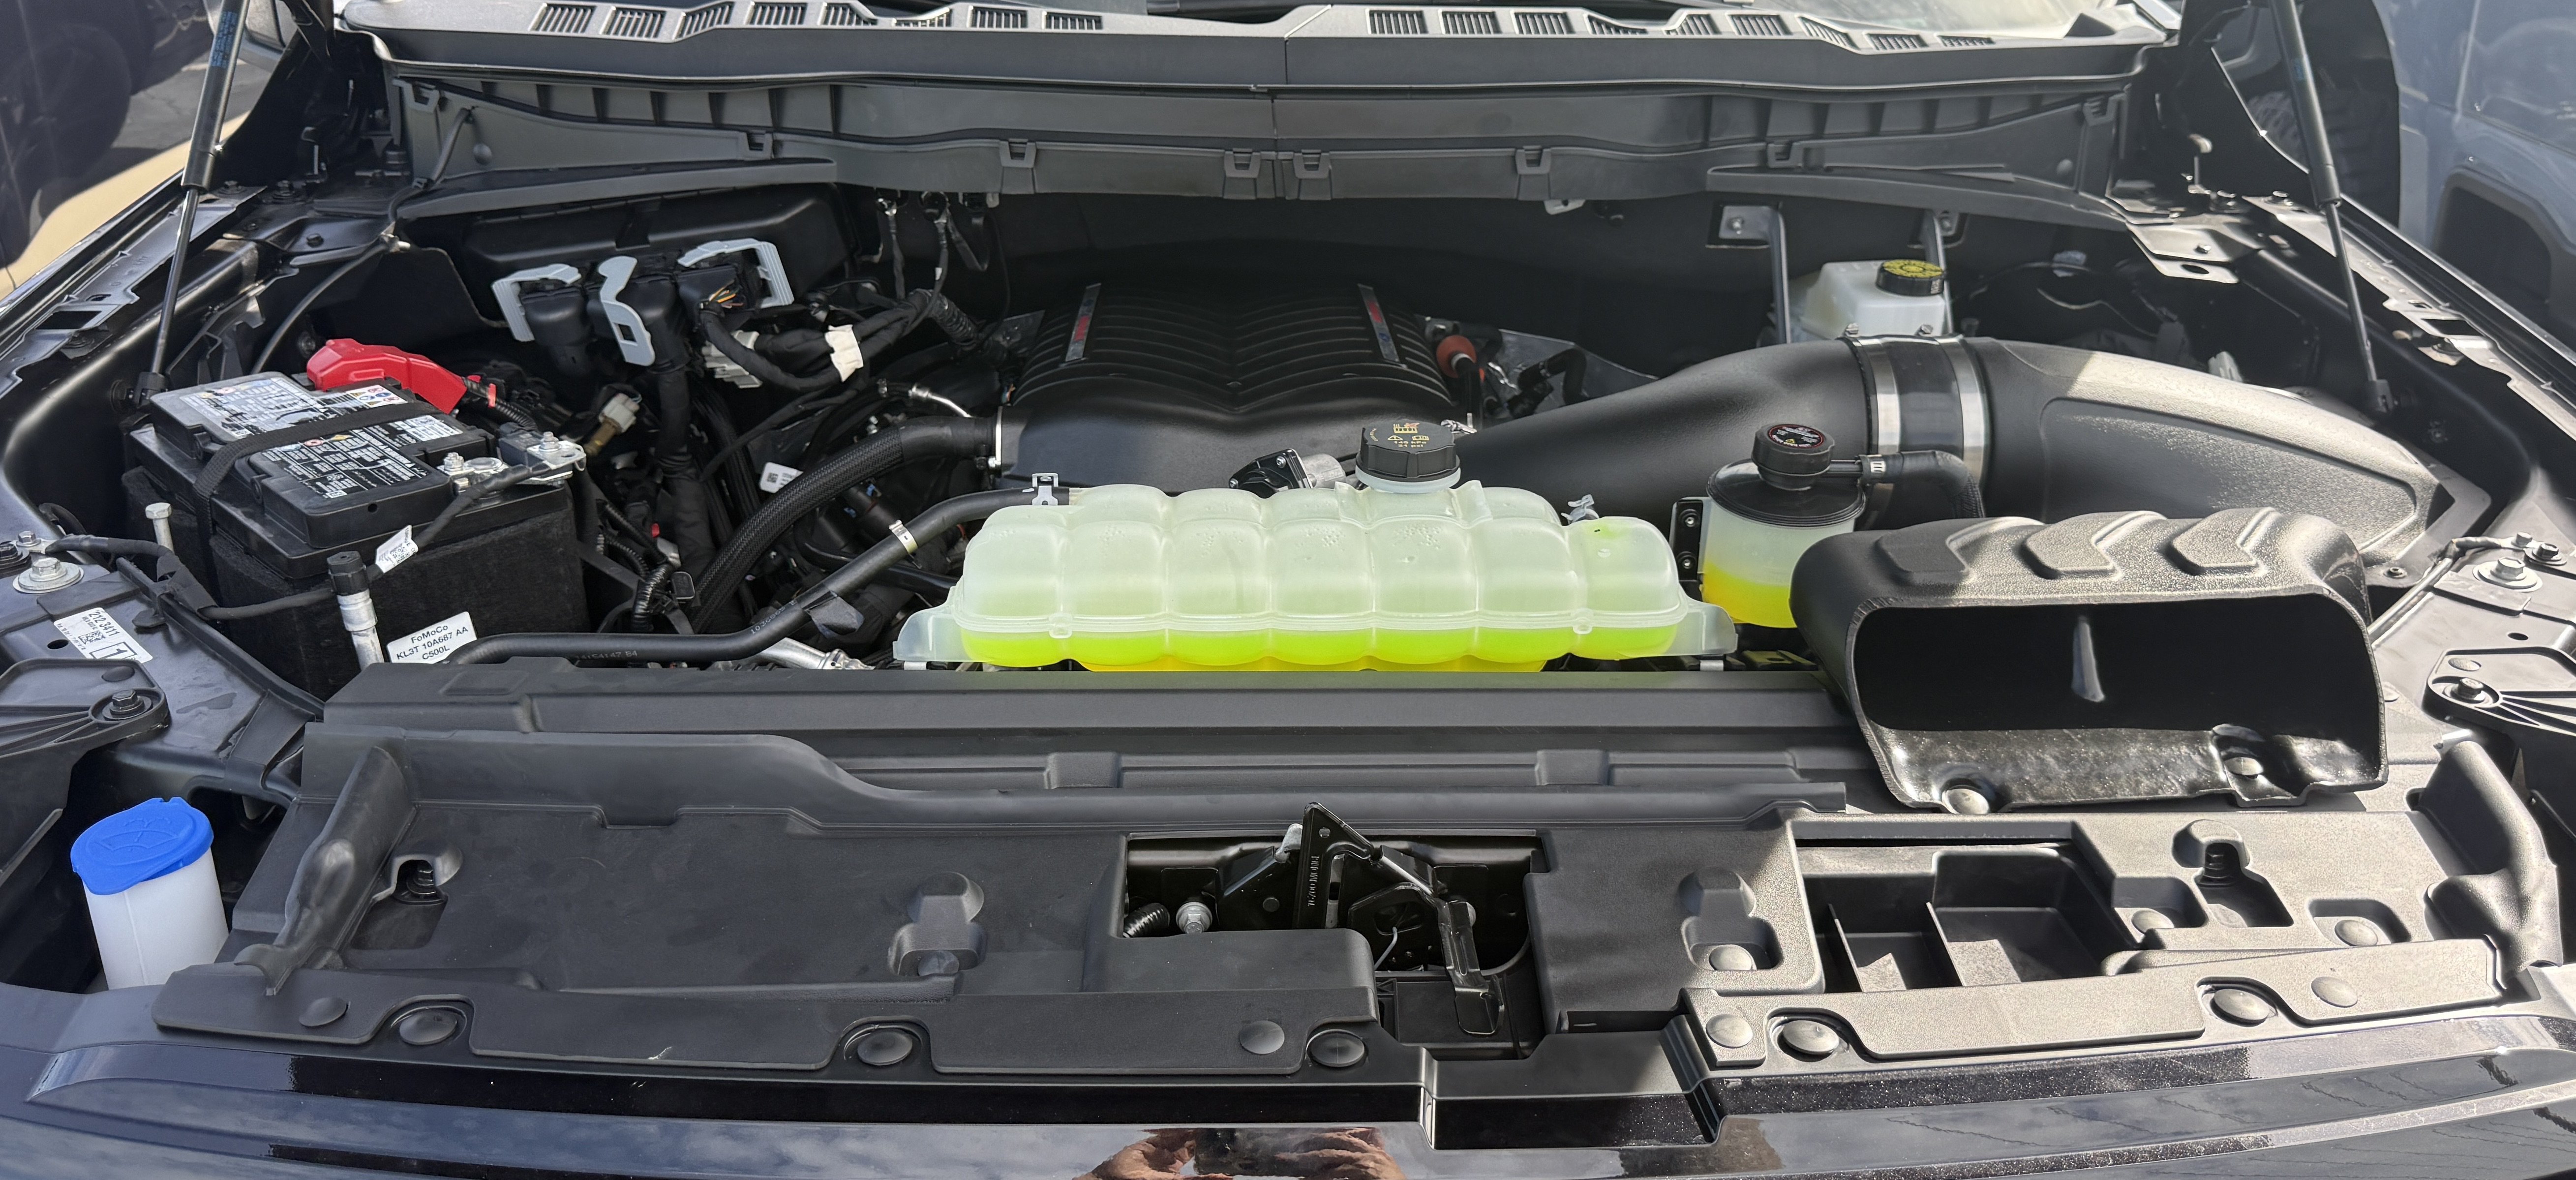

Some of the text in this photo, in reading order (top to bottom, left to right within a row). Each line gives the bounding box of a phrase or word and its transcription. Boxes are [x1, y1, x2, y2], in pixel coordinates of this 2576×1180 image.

[89, 611, 106, 623] 212
[99, 622, 120, 636] 3411
[411, 625, 448, 643] FoMoCo
[396, 627, 468, 660] KL3T 10A687 AA
[422, 645, 451, 660] C500L
